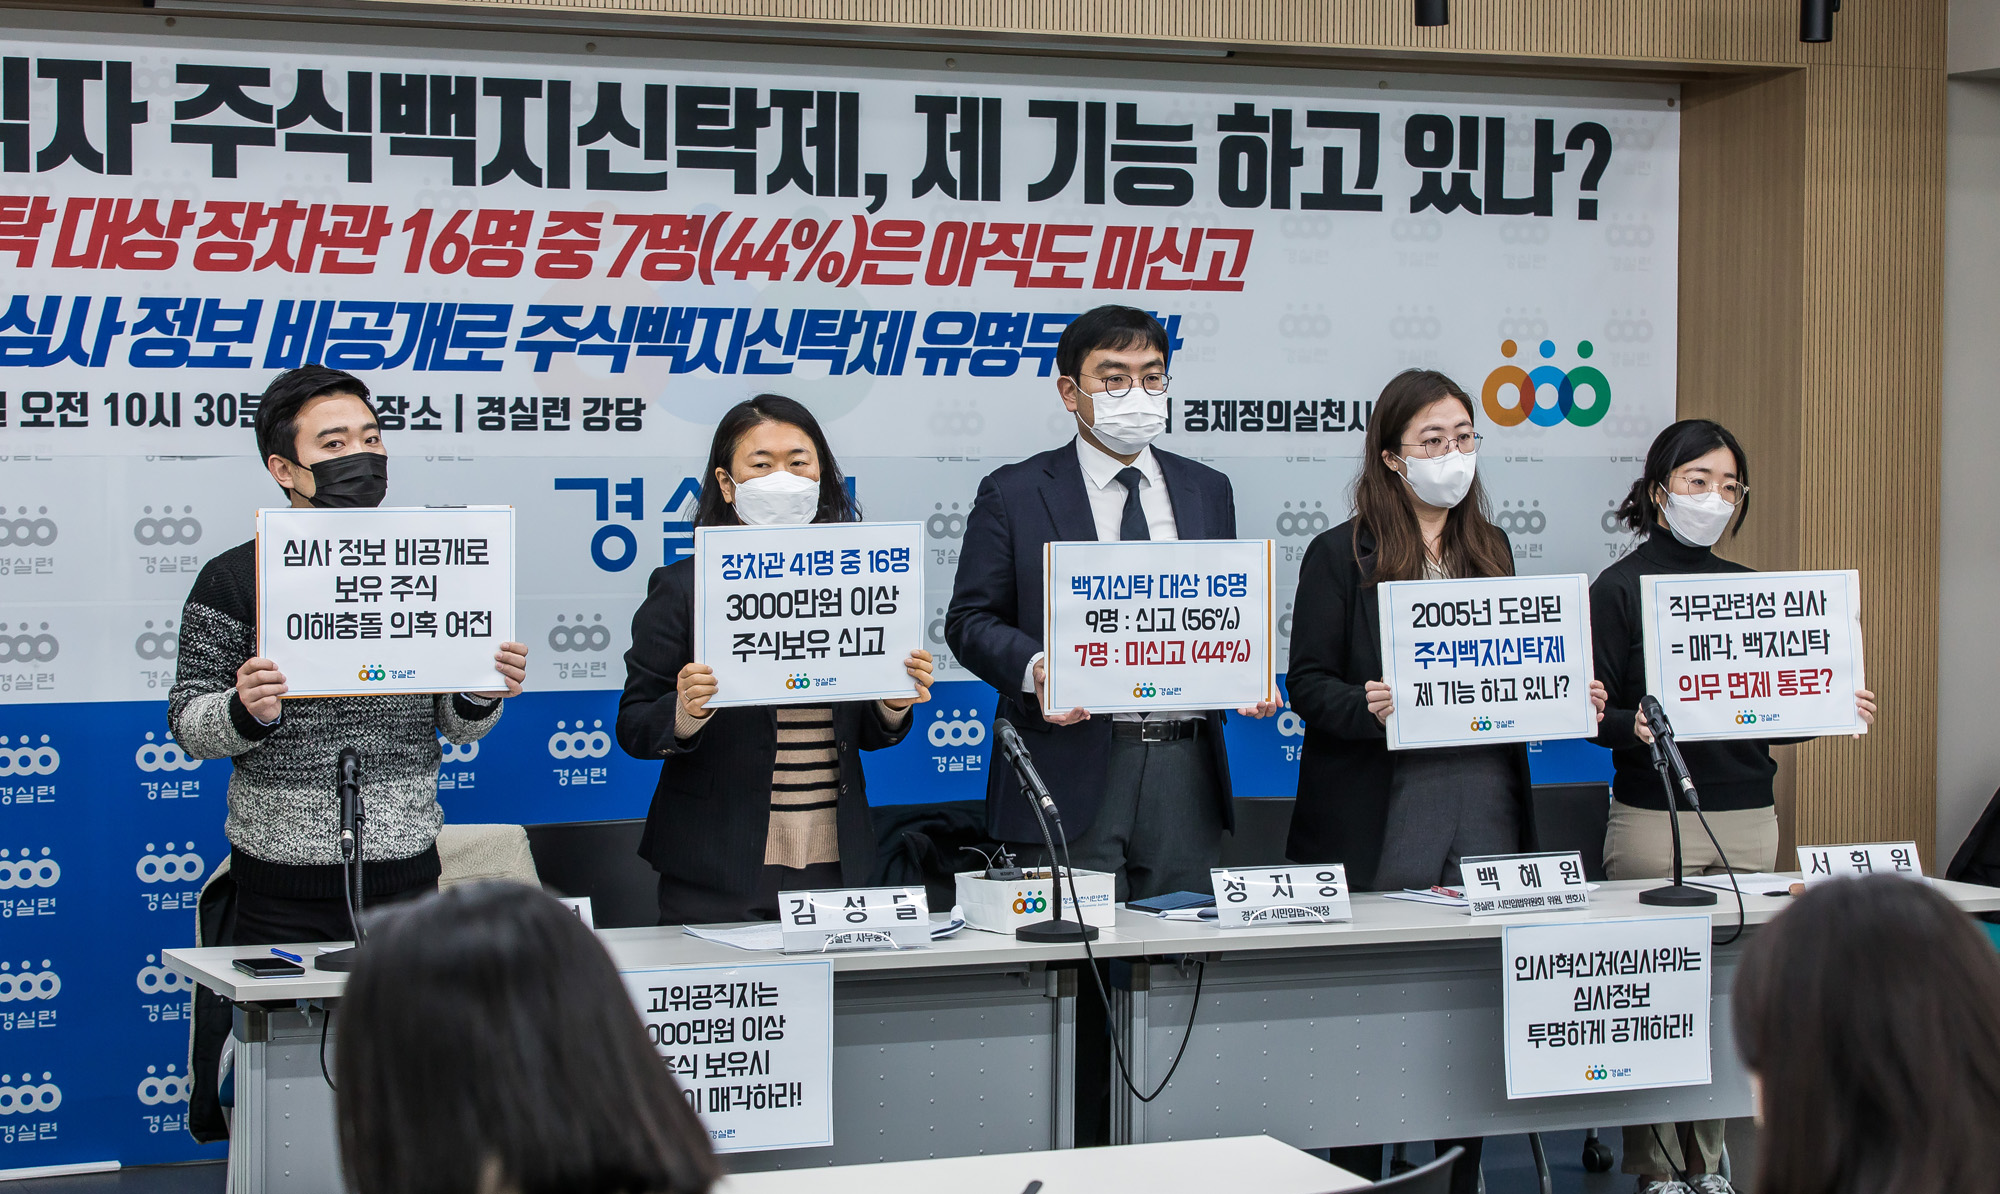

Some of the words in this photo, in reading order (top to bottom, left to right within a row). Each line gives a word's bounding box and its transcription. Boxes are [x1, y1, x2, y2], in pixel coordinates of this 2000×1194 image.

[171, 63, 887, 214] 주식백지신탁제,
[912, 94, 1001, 201] 제
[1028, 99, 1197, 208] 기능
[1217, 102, 1383, 212] 하고
[1404, 113, 1613, 221] 있나?
[51, 197, 196, 271] 대상
[192, 200, 393, 275] 장차관
[402, 209, 534, 279] 16명
[534, 211, 604, 279] 중
[607, 211, 924, 288] 7명(44%)은
[926, 221, 1093, 289] 아직도
[1093, 226, 1255, 292] 미신고
[0, 295, 127, 368] 심사
[130, 296, 261, 369] 정보
[263, 299, 514, 371] 비공개로
[515, 304, 917, 376] 주식백지신탁제
[20, 391, 89, 428] 오전
[104, 391, 181, 428] 10시
[477, 397, 571, 433] 경실련
[582, 397, 647, 433] 강당
[139, 556, 199, 574] 경실련
[283, 539, 332, 567] 심사
[338, 539, 386, 566] 정보
[395, 538, 489, 566] 비공개로
[721, 552, 785, 581] 장차관
[789, 550, 834, 577] 41명
[839, 548, 861, 575] 중
[868, 547, 911, 574] 16명
[335, 575, 383, 603] 보유
[390, 575, 437, 602] 주식
[1072, 574, 1154, 601] 백지신탁
[1159, 573, 1200, 600] 대상
[1206, 572, 1248, 599] 16명
[726, 587, 842, 621] 3000만원
[850, 585, 899, 616] 이상
[1412, 598, 1491, 629] 2005년
[1499, 595, 1562, 625] 도입된
[1669, 592, 1777, 623] 직무관련성
[1783, 590, 1827, 617] 심사
[286, 612, 383, 641] 이해충돌
[390, 610, 438, 639] 의혹
[445, 610, 492, 637] 여전
[1085, 610, 1119, 633] 9명
[1136, 608, 1176, 632] 신고
[1181, 606, 1240, 632] (56%)
[732, 629, 831, 663] 주식보유
[838, 627, 885, 658] 신고
[1074, 644, 1108, 667] 7명
[1125, 640, 1186, 667] 미신고
[1191, 639, 1251, 665] (44%)
[1414, 635, 1565, 670] 주식백지신탁제
[1742, 629, 1830, 659] 백지신탁
[388, 669, 416, 680] 경실련
[553, 661, 607, 679] 경실련
[813, 677, 837, 687] 경실련
[1159, 686, 1182, 696] 경실련
[1413, 682, 1434, 707] 제
[1437, 680, 1475, 705] 기능
[1481, 678, 1518, 703] 하고
[1523, 675, 1570, 701] 있나?
[1678, 672, 1722, 702] 의무
[1727, 670, 1771, 699] 면제
[1777, 668, 1833, 697] 통로?
[1494, 719, 1515, 729] 경실련
[553, 767, 607, 786] 경실련
[932, 755, 981, 773] 경실련
[141, 781, 200, 800] 경실련
[141, 891, 200, 912] 경실련
[1473, 901, 1495, 912] 경실련
[1498, 896, 1545, 909] 시민입법위원회
[1565, 893, 1586, 904] 변호사
[1514, 945, 1702, 982] 인사혁신처(심사위)는
[646, 982, 779, 1013] 고위공직자는
[1573, 982, 1650, 1012] 심사정보
[742, 1015, 786, 1042] 이상
[1527, 1016, 1605, 1050] 투명하게
[1611, 1013, 1694, 1044] 공개하라!
[704, 1050, 770, 1079] 보유시
[1609, 1067, 1632, 1078] 경실련
[709, 1081, 802, 1113] 매각하라!
[709, 1128, 736, 1140] 경실련
